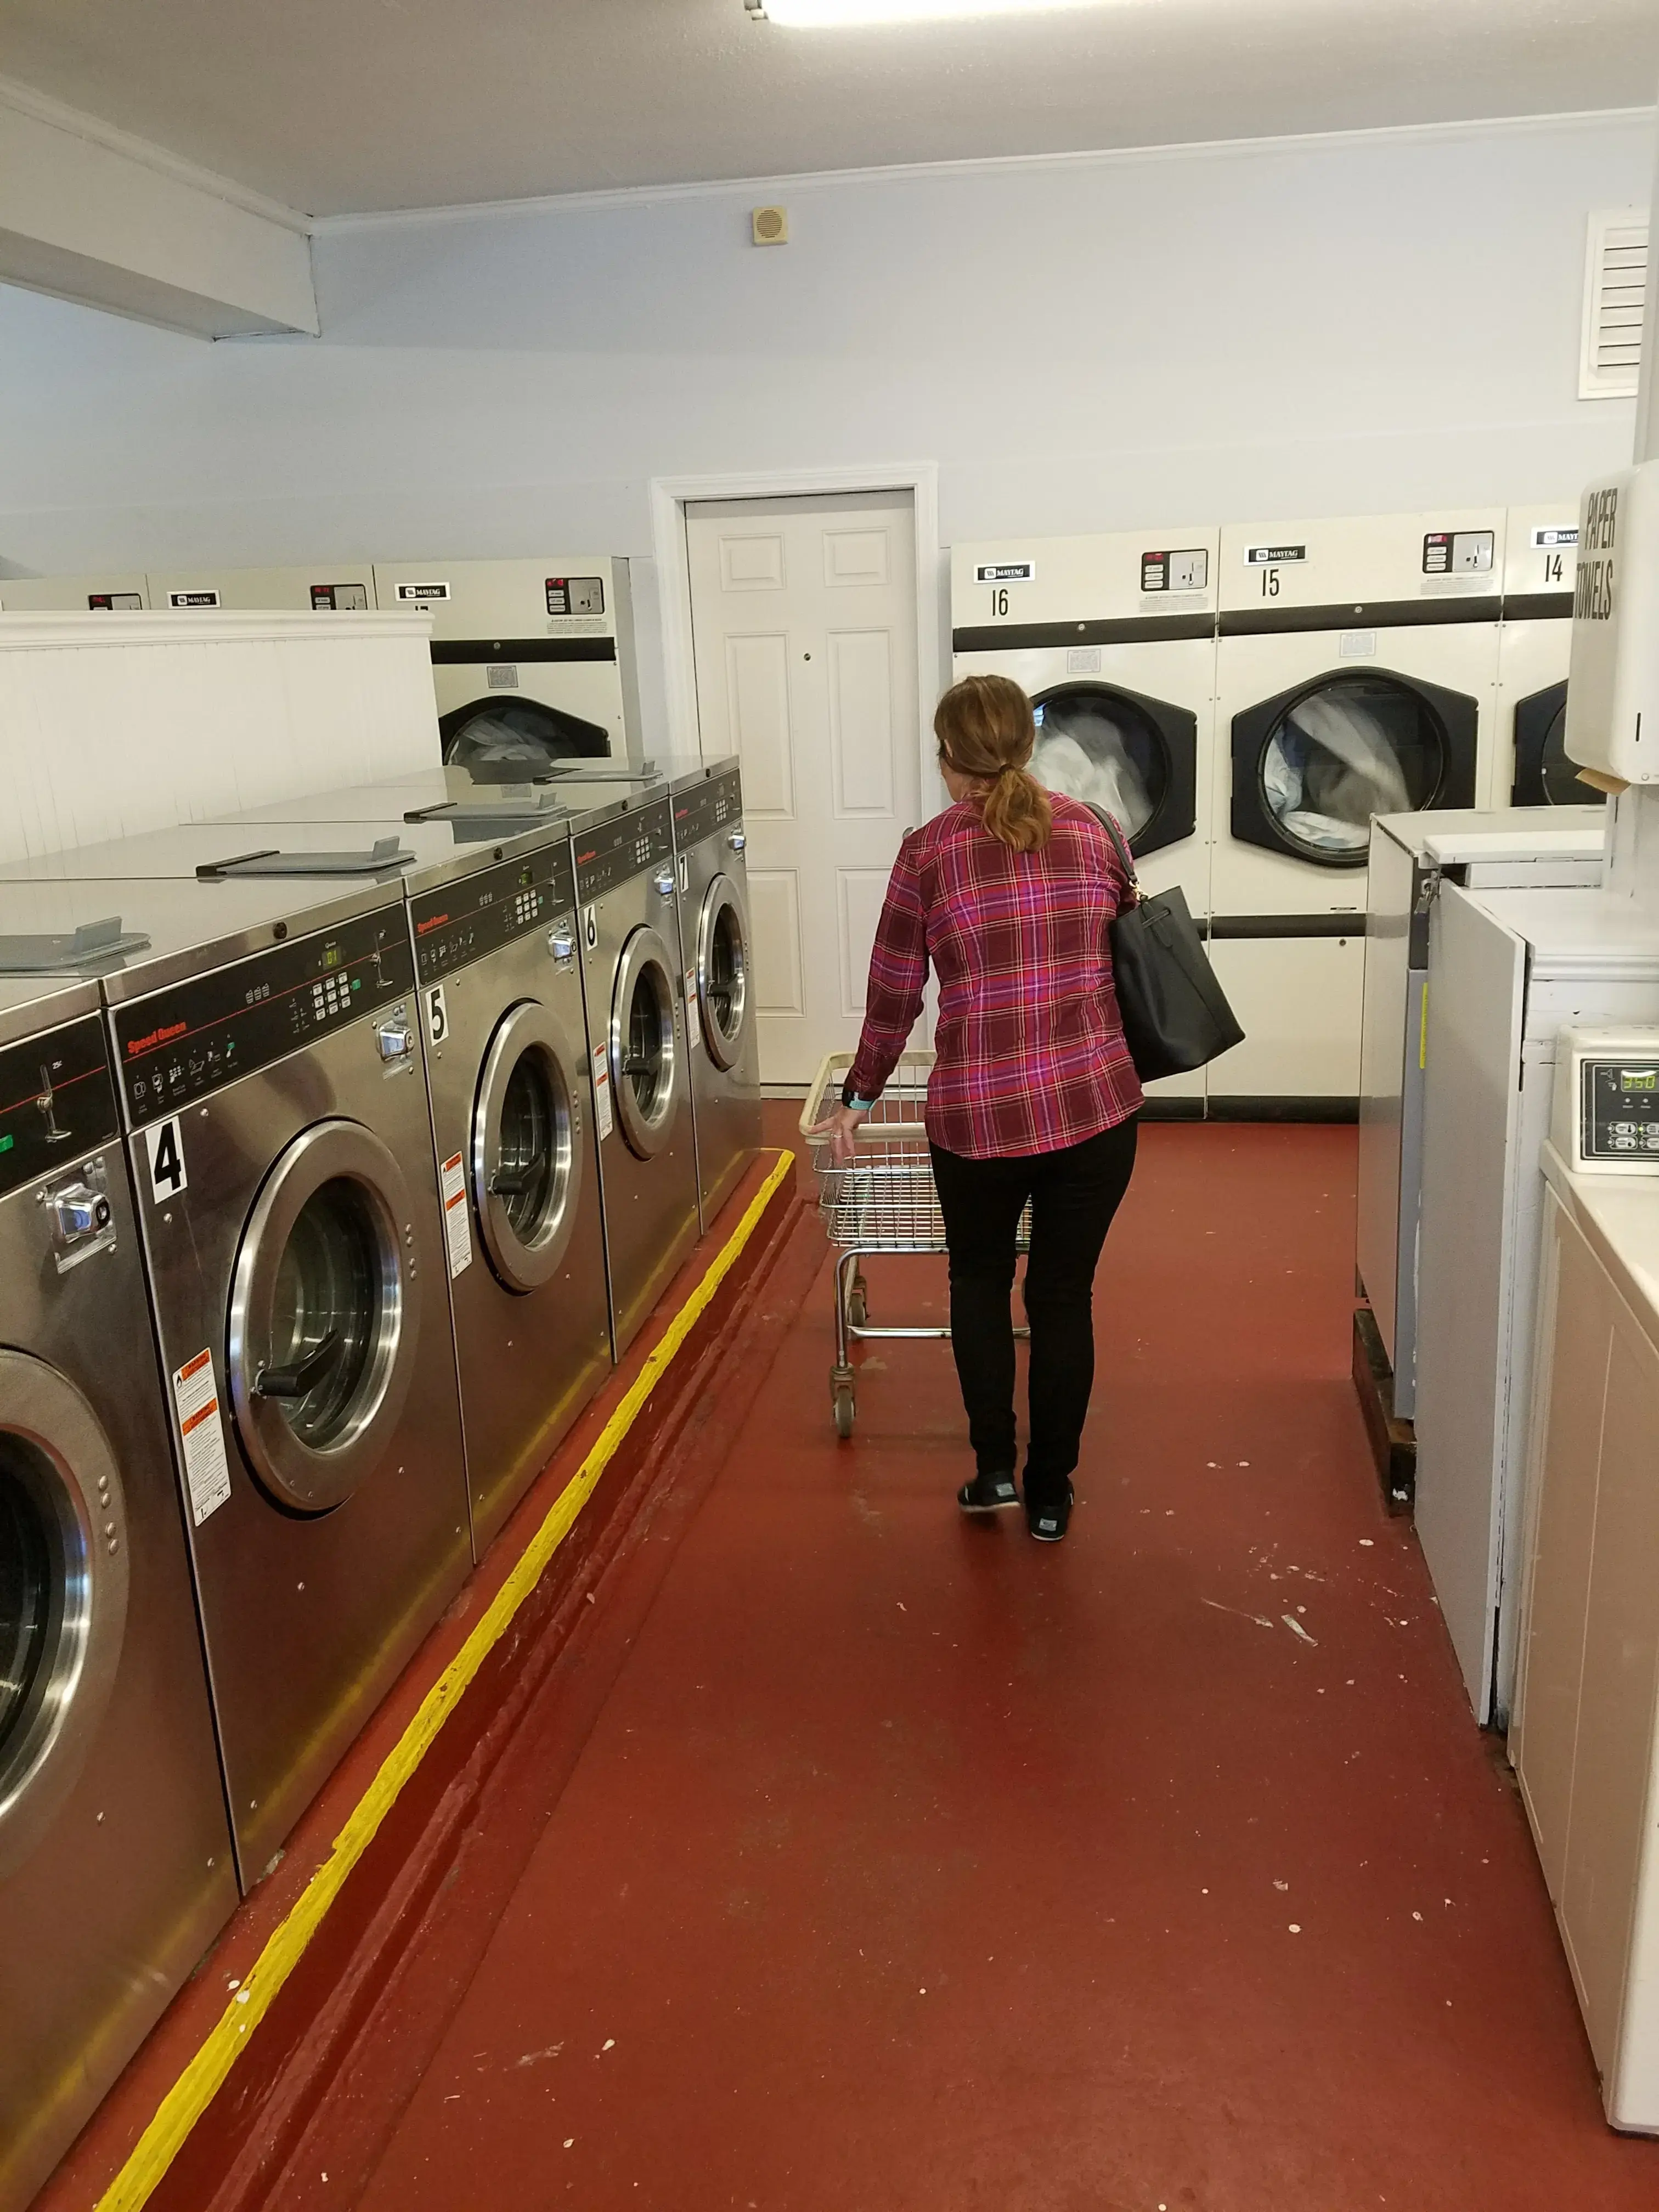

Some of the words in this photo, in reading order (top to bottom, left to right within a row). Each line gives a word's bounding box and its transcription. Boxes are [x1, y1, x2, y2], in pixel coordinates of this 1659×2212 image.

[1585, 487, 1618, 550] PAPER
[1269, 550, 1298, 558] MAYTAG
[1545, 554, 1562, 582] 14
[996, 568, 1024, 577] MAYTAG
[1262, 568, 1279, 596] 15
[992, 589, 1008, 616] 16
[1573, 559, 1613, 620] TOWELS
[680, 856, 685, 890] 7
[588, 907, 595, 946] 6
[431, 989, 444, 1040] 5
[127, 1030, 157, 1054] Speed
[154, 1121, 182, 1190] 4
